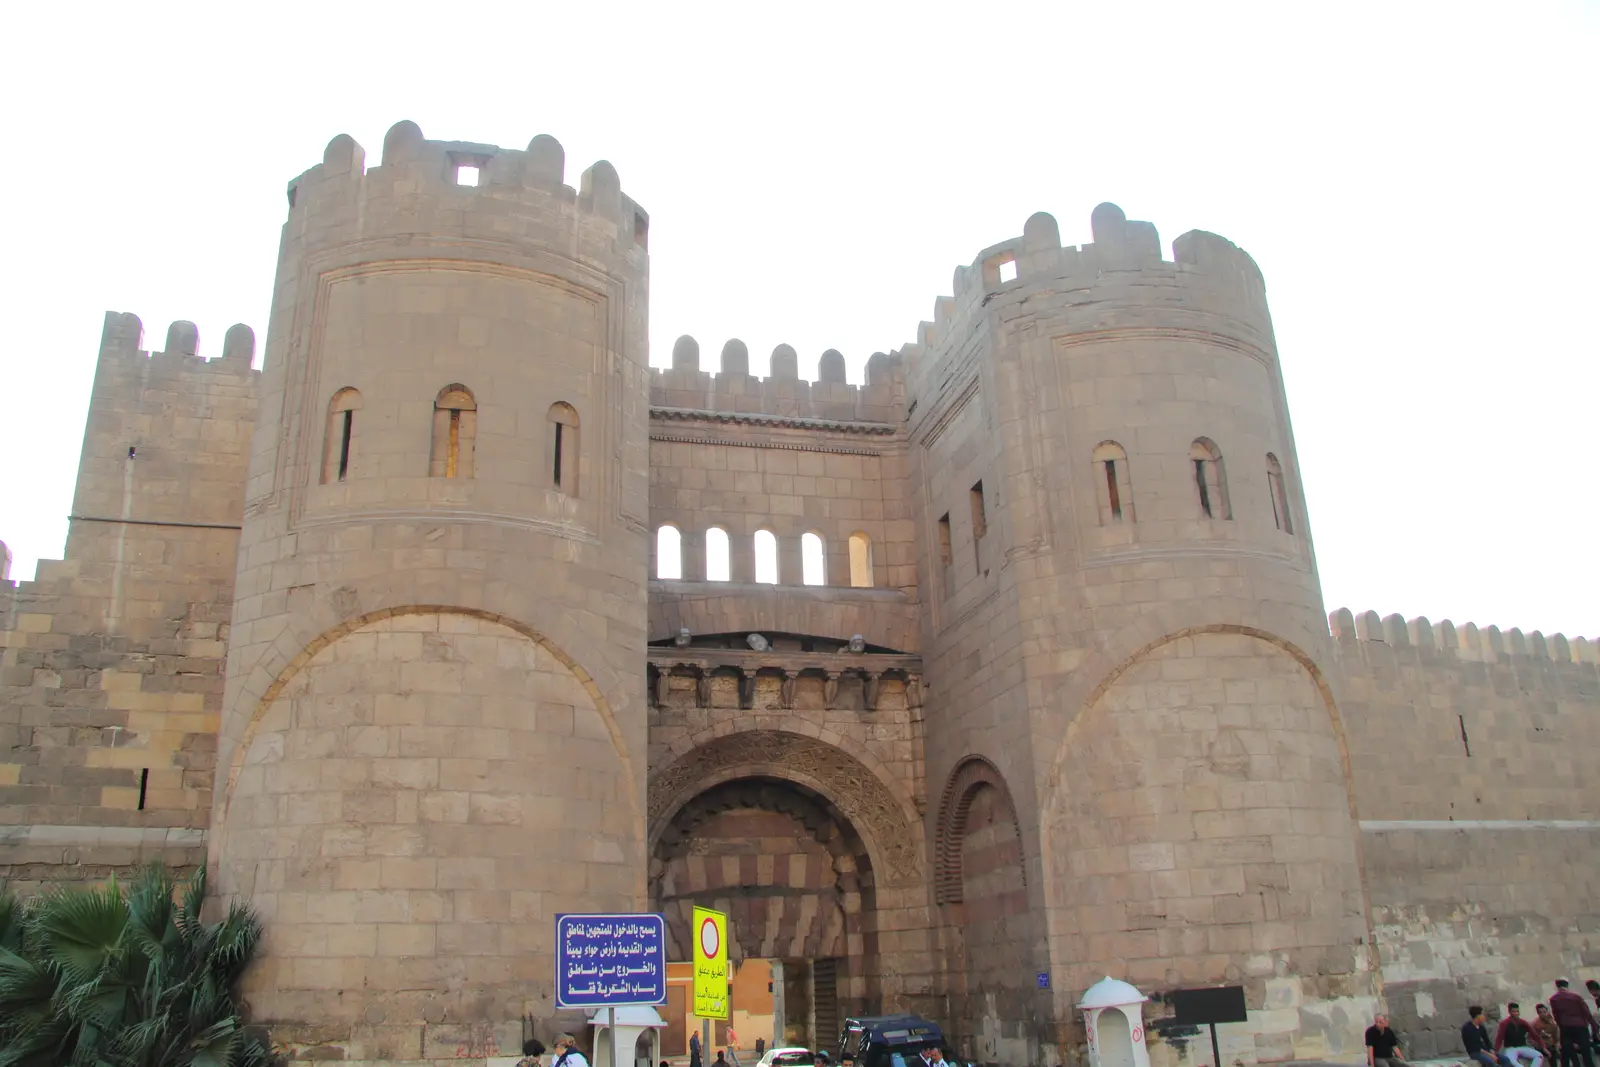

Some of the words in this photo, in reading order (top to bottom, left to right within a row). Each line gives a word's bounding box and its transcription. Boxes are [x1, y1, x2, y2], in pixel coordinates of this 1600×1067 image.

[613, 923, 639, 938] بالدخول
[640, 925, 656, 938] يسمح
[618, 941, 642, 957] القديمة
[643, 945, 657, 957] مصر
[599, 964, 616, 977] من
[568, 981, 596, 995] فقط
[632, 981, 656, 996] باب
